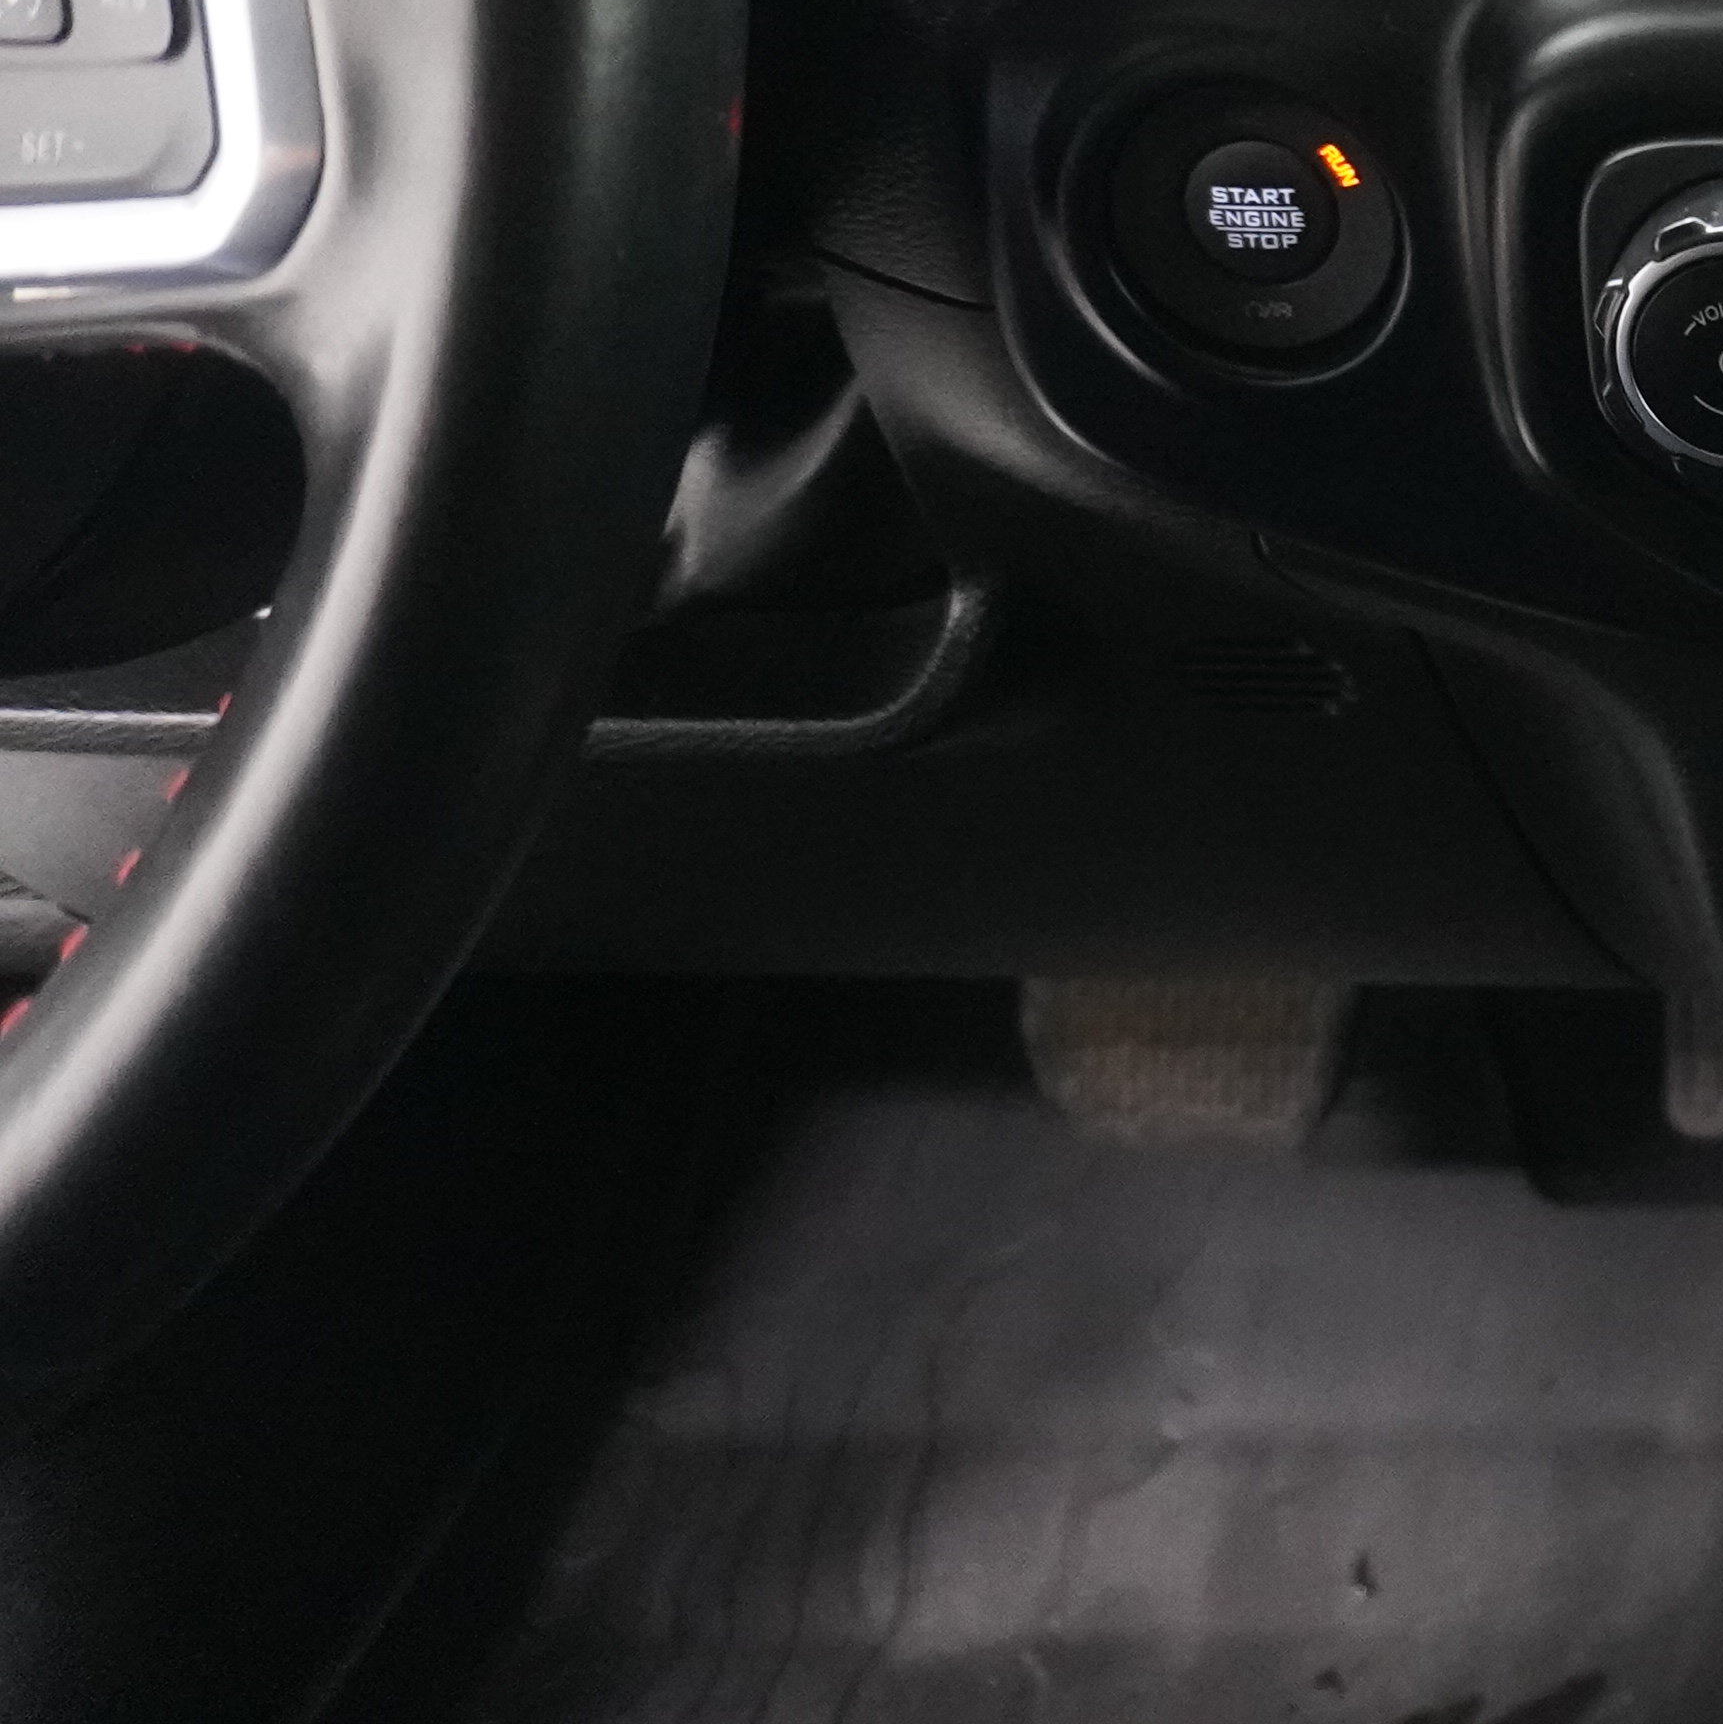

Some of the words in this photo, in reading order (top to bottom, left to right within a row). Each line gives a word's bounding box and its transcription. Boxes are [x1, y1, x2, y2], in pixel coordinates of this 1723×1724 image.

[1316, 143, 1359, 188] RUN
[1210, 185, 1295, 206] START
[1209, 209, 1306, 228] ENGINE
[1227, 233, 1298, 249] STOP
